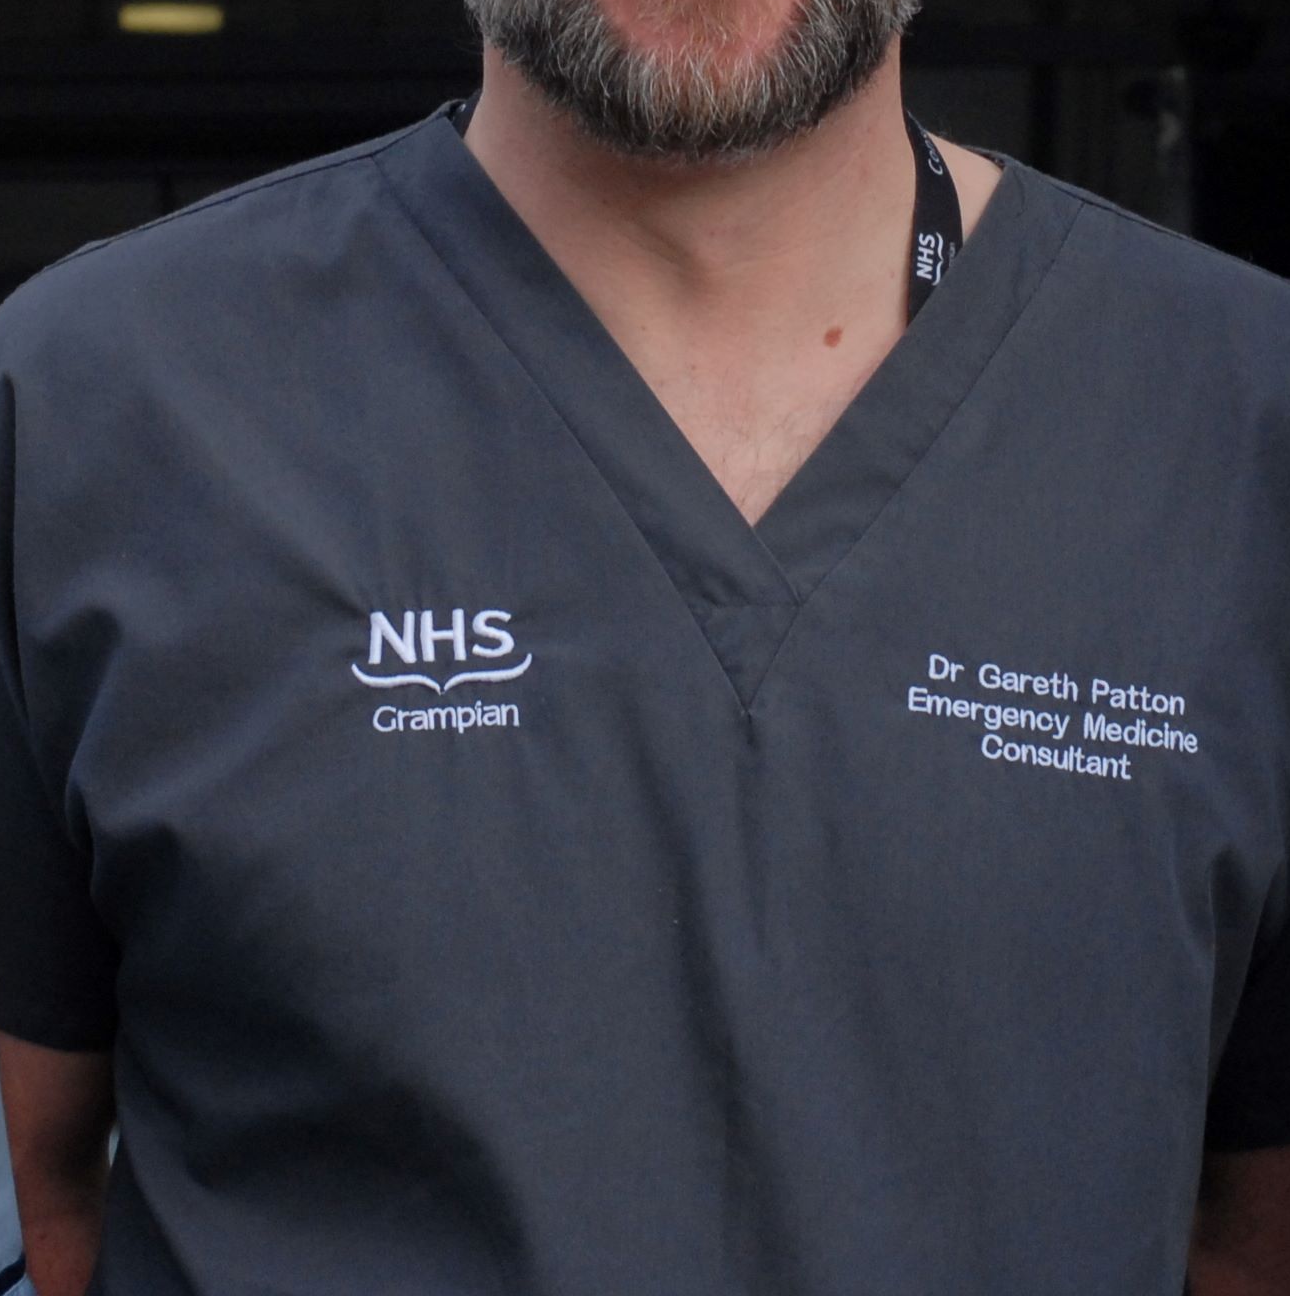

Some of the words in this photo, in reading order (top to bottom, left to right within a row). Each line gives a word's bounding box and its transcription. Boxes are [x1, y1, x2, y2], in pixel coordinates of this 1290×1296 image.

[916, 232, 936, 280] NHS
[368, 608, 515, 664] NHS
[928, 654, 965, 682] Dr
[978, 663, 1078, 702] Gareth
[1091, 678, 1185, 716] Patton
[372, 700, 520, 733] Grampian
[908, 686, 1069, 739] Emergency
[1083, 712, 1199, 753] Medicine
[981, 733, 1132, 780] Consultant
